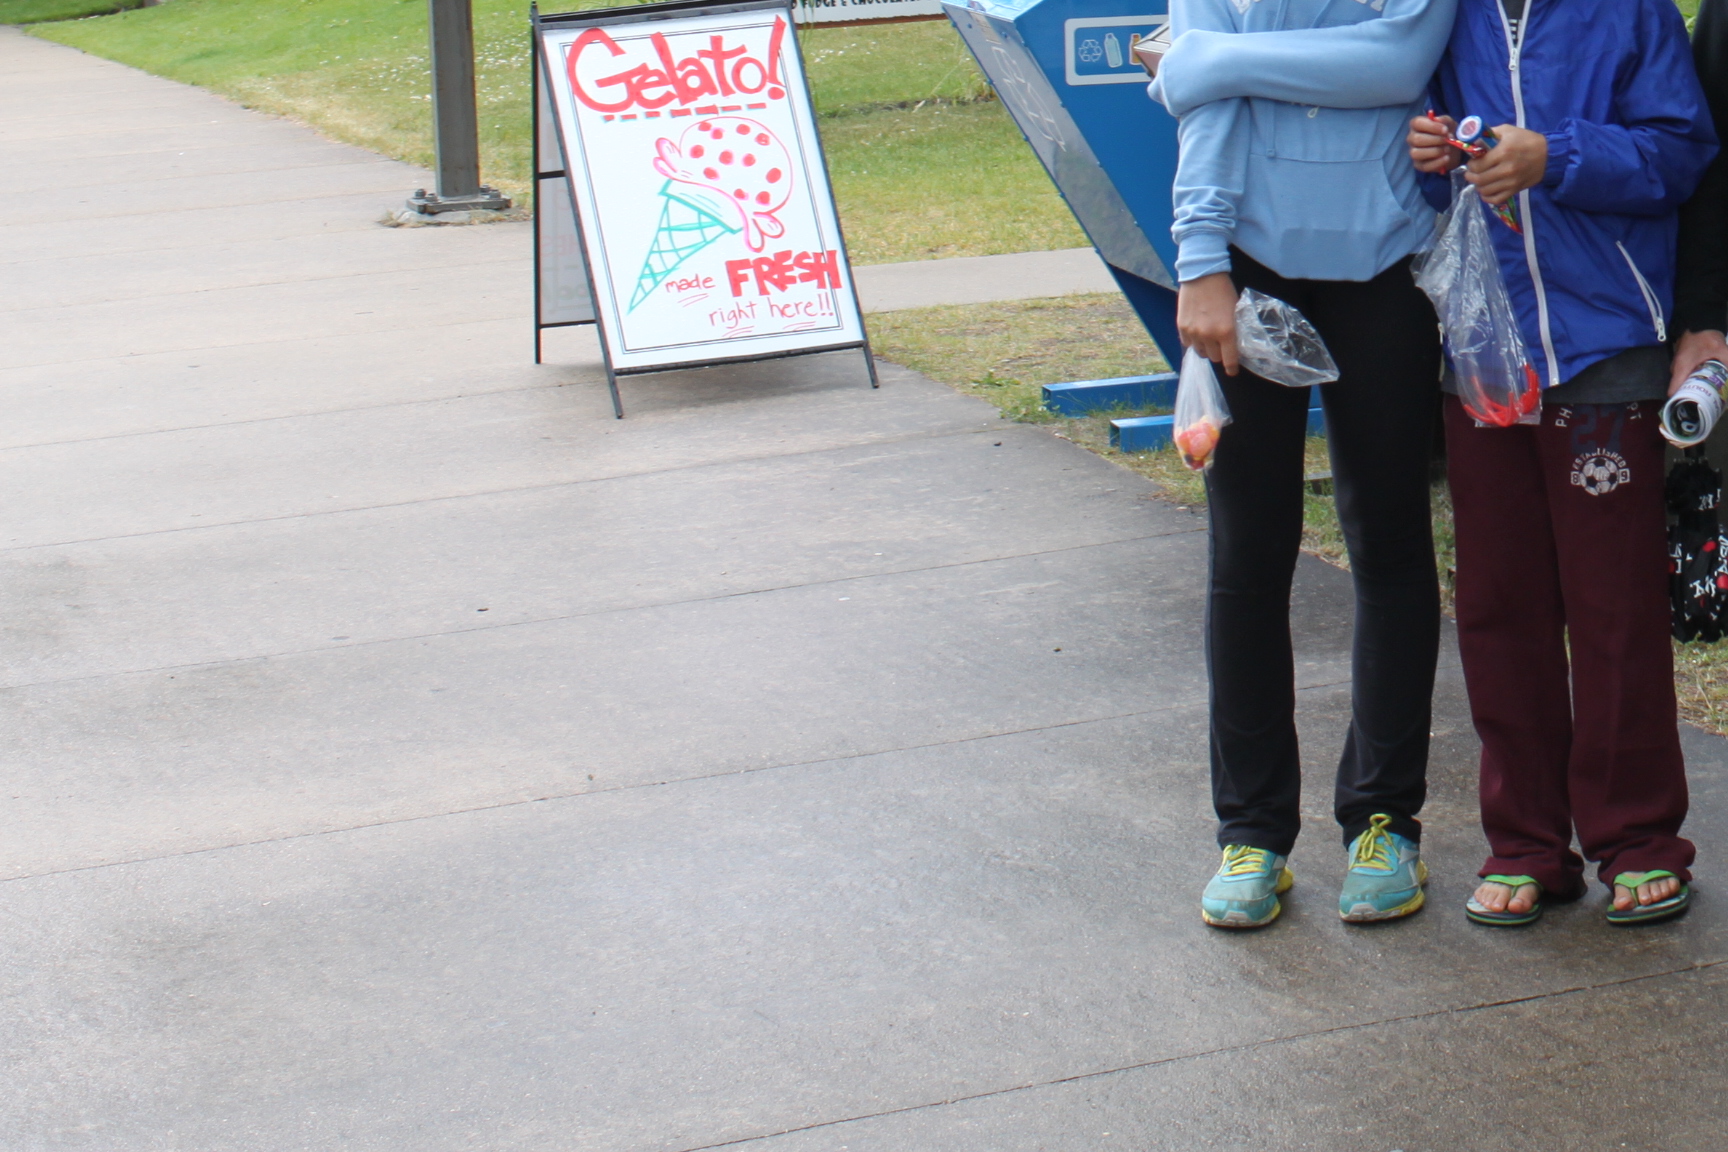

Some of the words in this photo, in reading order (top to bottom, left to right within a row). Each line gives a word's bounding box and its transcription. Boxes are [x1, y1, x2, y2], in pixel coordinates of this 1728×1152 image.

[566, 14, 787, 114] Gelato!
[665, 272, 716, 294] made
[725, 249, 842, 297] FRESH
[708, 298, 758, 329] right
[768, 293, 834, 319] here!!
